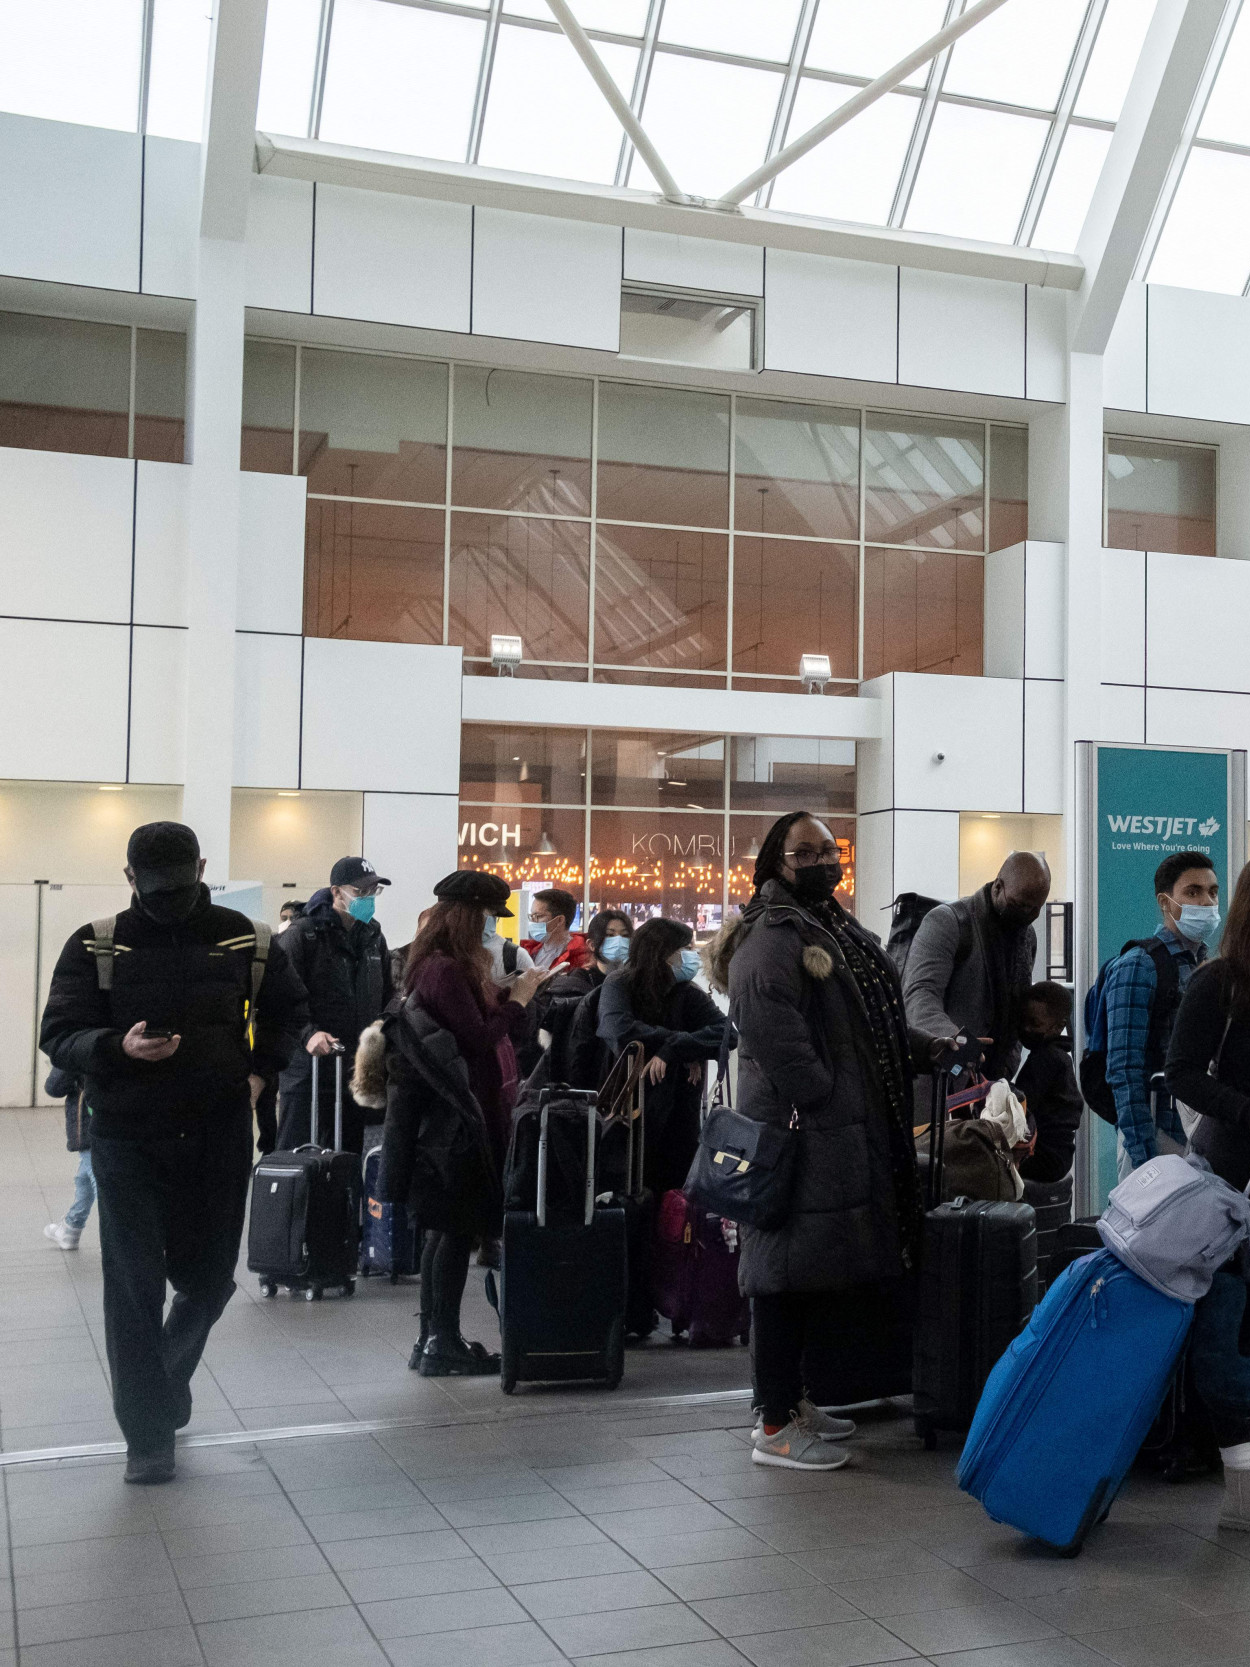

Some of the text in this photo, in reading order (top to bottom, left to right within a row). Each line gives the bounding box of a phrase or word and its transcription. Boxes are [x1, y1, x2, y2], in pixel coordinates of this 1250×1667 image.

[1107, 815, 1197, 841] WESTJET
[1112, 842, 1210, 854] Love Where You're Going
